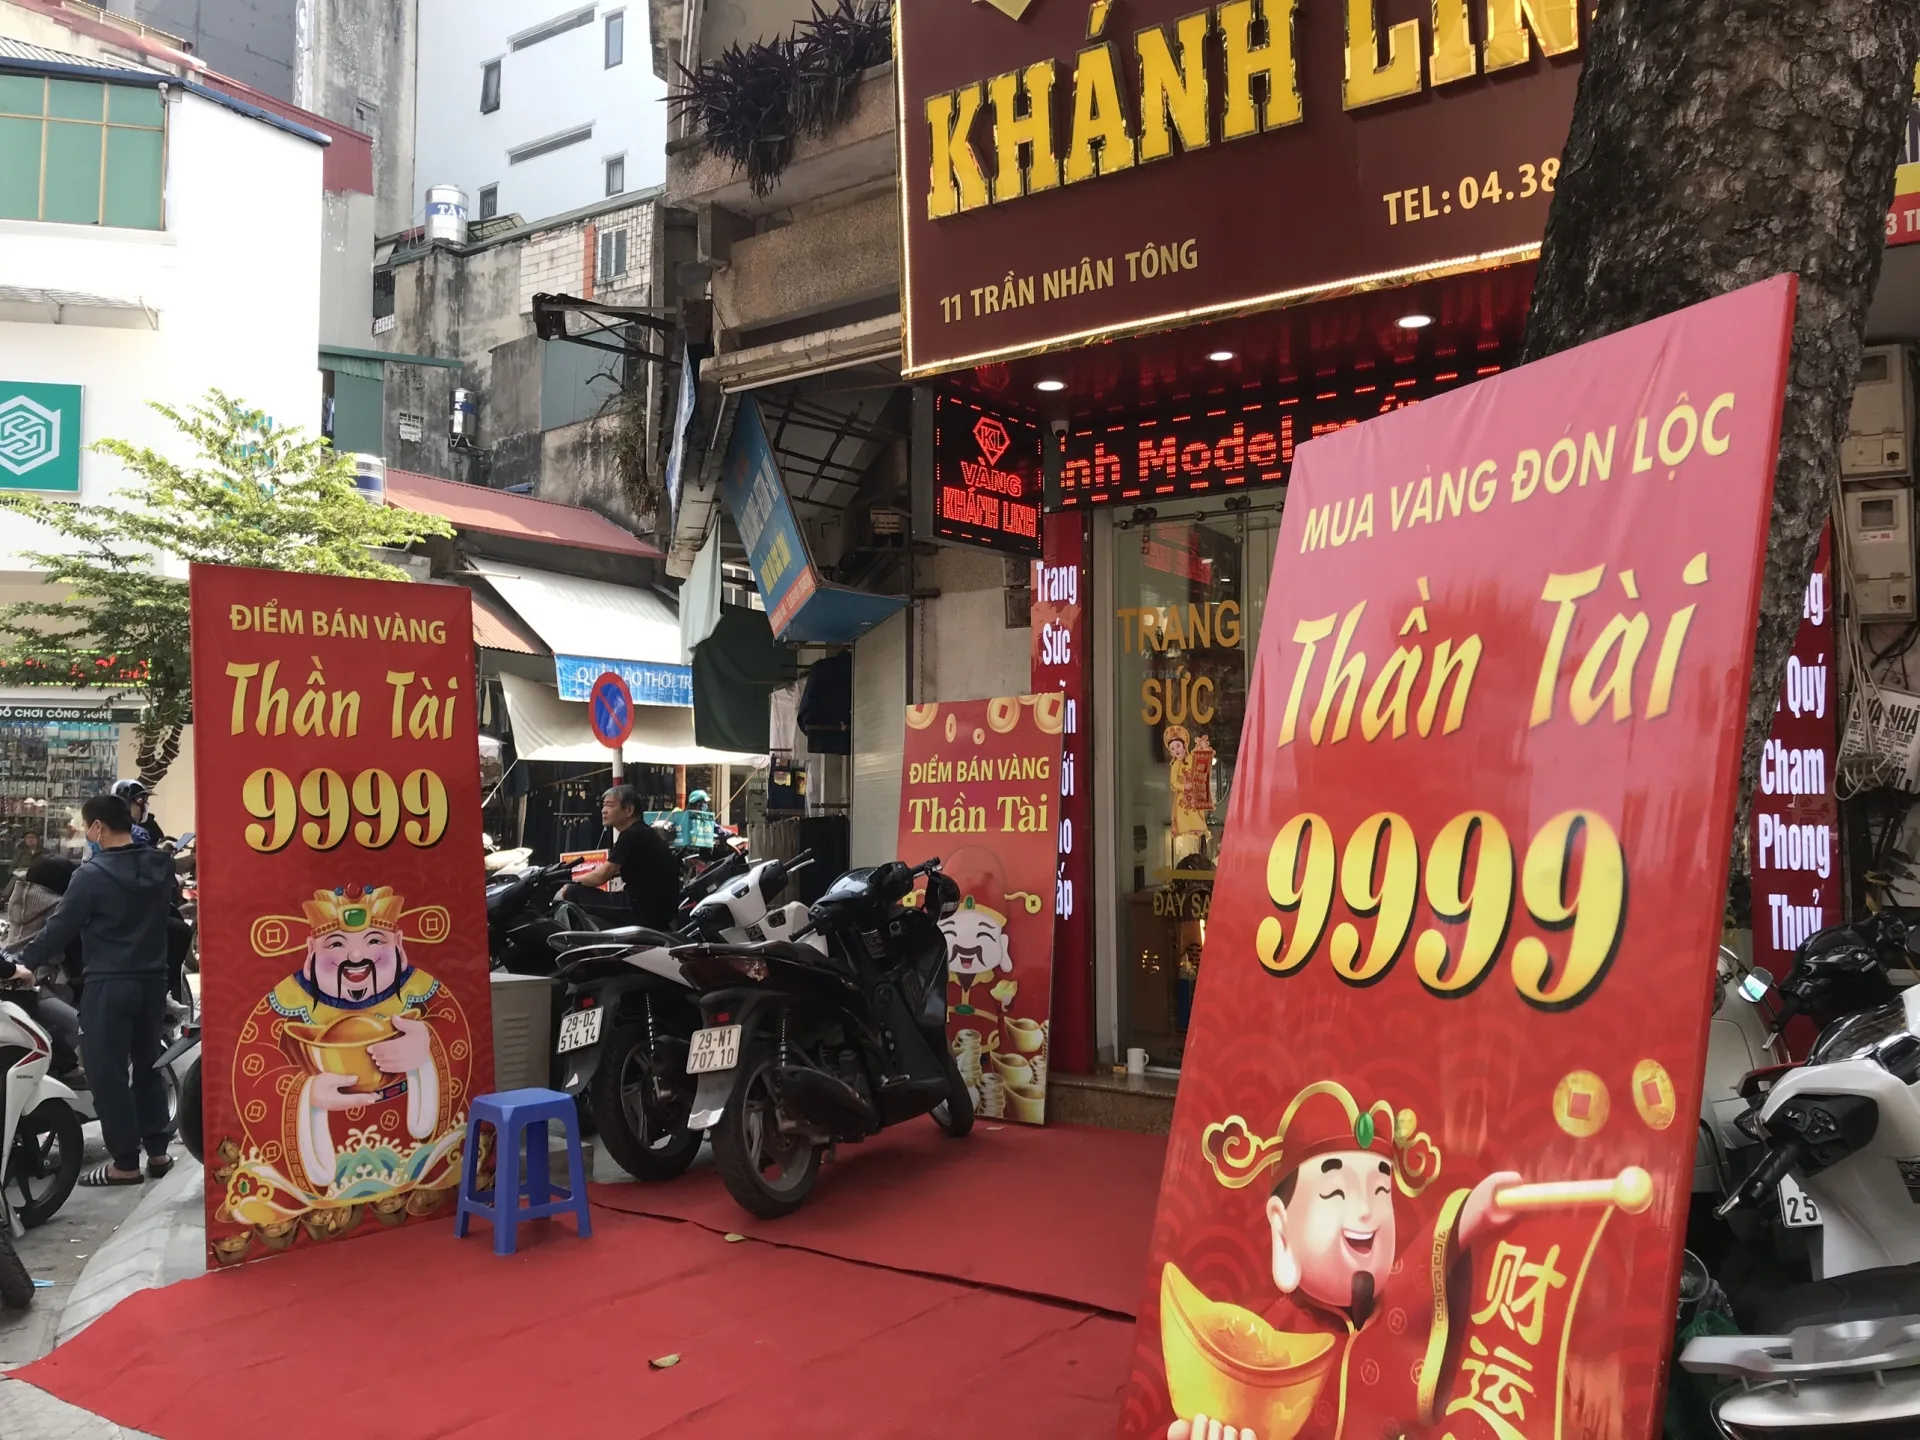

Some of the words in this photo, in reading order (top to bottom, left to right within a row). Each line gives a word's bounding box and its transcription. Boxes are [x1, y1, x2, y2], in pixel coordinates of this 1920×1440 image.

[925, 0, 1302, 220] KHÁNH
[1341, 0, 1598, 112] LIN
[1383, 185, 1452, 226] TEL:
[940, 296, 963, 324] 11
[971, 270, 1035, 318] TRẦN
[1043, 257, 1114, 302] NHÂN
[1126, 237, 1199, 284] TÔNG
[1139, 415, 1293, 482] Model
[1300, 506, 1375, 553] MUA
[1390, 460, 1497, 533] VÀNG
[1511, 426, 1618, 503] ĐÓN
[1631, 391, 1735, 482] LỘC
[961, 456, 1022, 498] VÀNG
[943, 486, 999, 530] KHÁNH
[1003, 501, 1037, 538] LINH
[1036, 562, 1077, 605] Trang
[230, 598, 304, 635] ĐIỂM
[312, 604, 368, 639] BÁN
[373, 608, 447, 645] VÀNG
[1042, 617, 1071, 667] Sức
[1117, 599, 1240, 653] TRANG
[1278, 577, 1482, 748] Thần
[1529, 552, 1709, 729] Tài
[15, 708, 43, 719] CHƠI
[46, 708, 80, 720] CÔNG
[225, 656, 361, 738] Thần
[386, 669, 459, 740] Tài
[1141, 665, 1215, 725] SỨC
[1787, 653, 1827, 719] Quý
[909, 754, 952, 784] ĐIỂM
[957, 756, 994, 783] BÁN
[998, 752, 1050, 782] VÀNG
[1760, 738, 1825, 796] Cham
[242, 768, 450, 853] 9999
[909, 791, 987, 834] Thần
[997, 793, 1049, 833] Tài
[1759, 813, 1830, 879] Phong
[1256, 809, 1629, 1013] 9999
[560, 1026, 596, 1051] 514.14
[690, 1047, 735, 1070] 707.10
